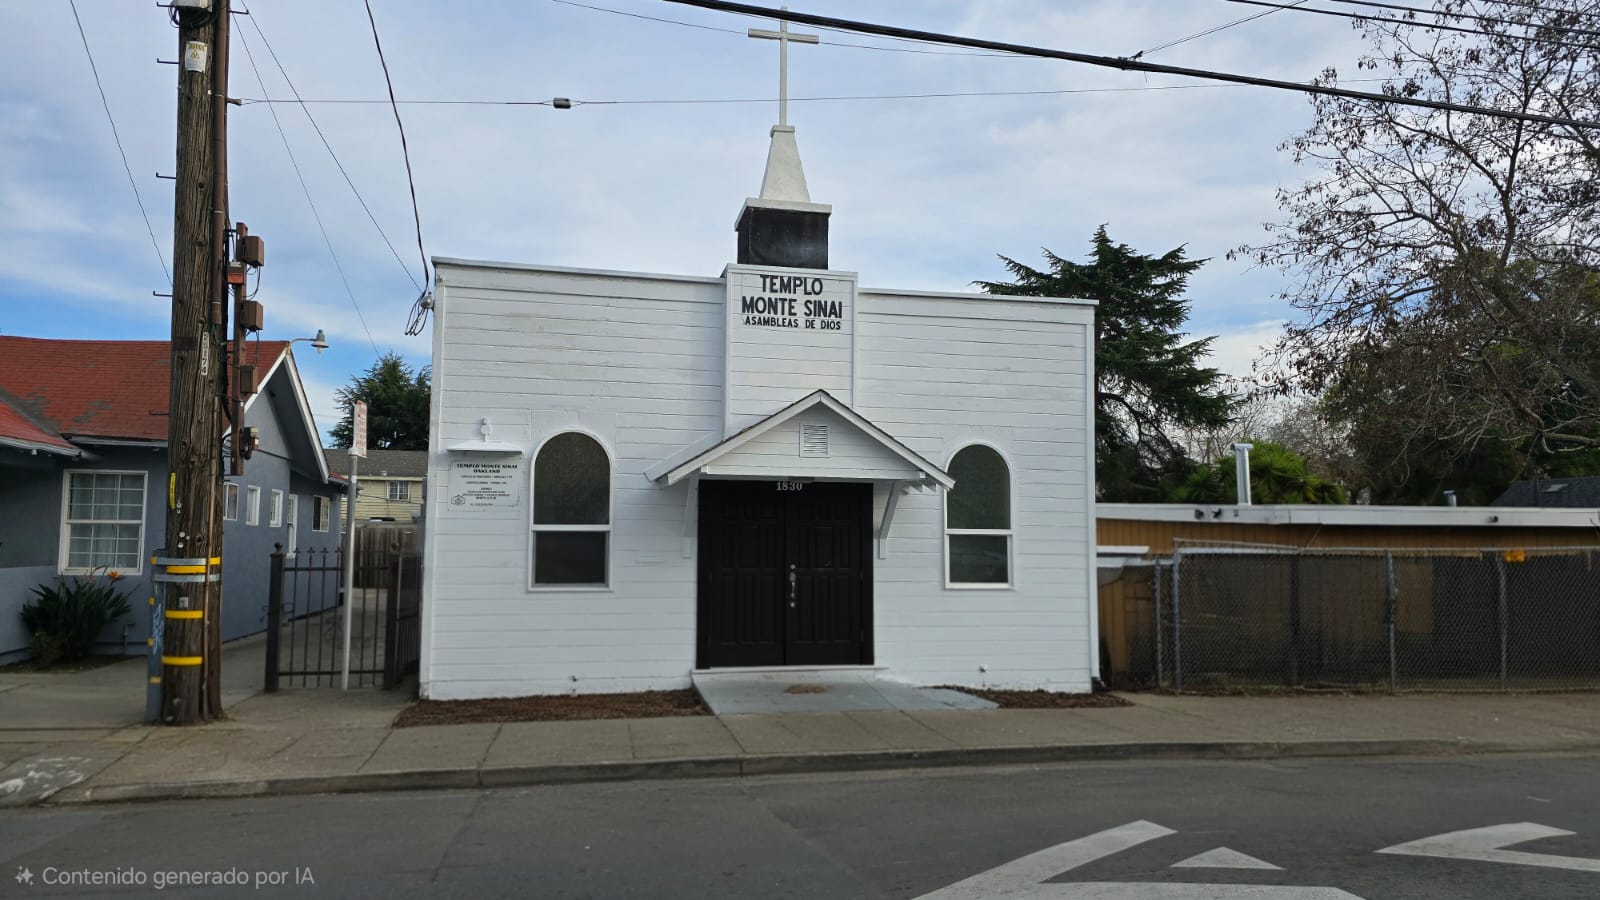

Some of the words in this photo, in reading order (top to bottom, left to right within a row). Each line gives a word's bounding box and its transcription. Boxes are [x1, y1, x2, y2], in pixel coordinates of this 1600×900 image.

[760, 274, 823, 295] TEMPLO
[742, 296, 797, 316] MONTE
[804, 300, 842, 318] SINAI
[745, 316, 799, 328] ASAMBLEAS
[805, 319, 815, 329] DE
[820, 320, 841, 330] DIOS
[776, 480, 802, 491] 1830
